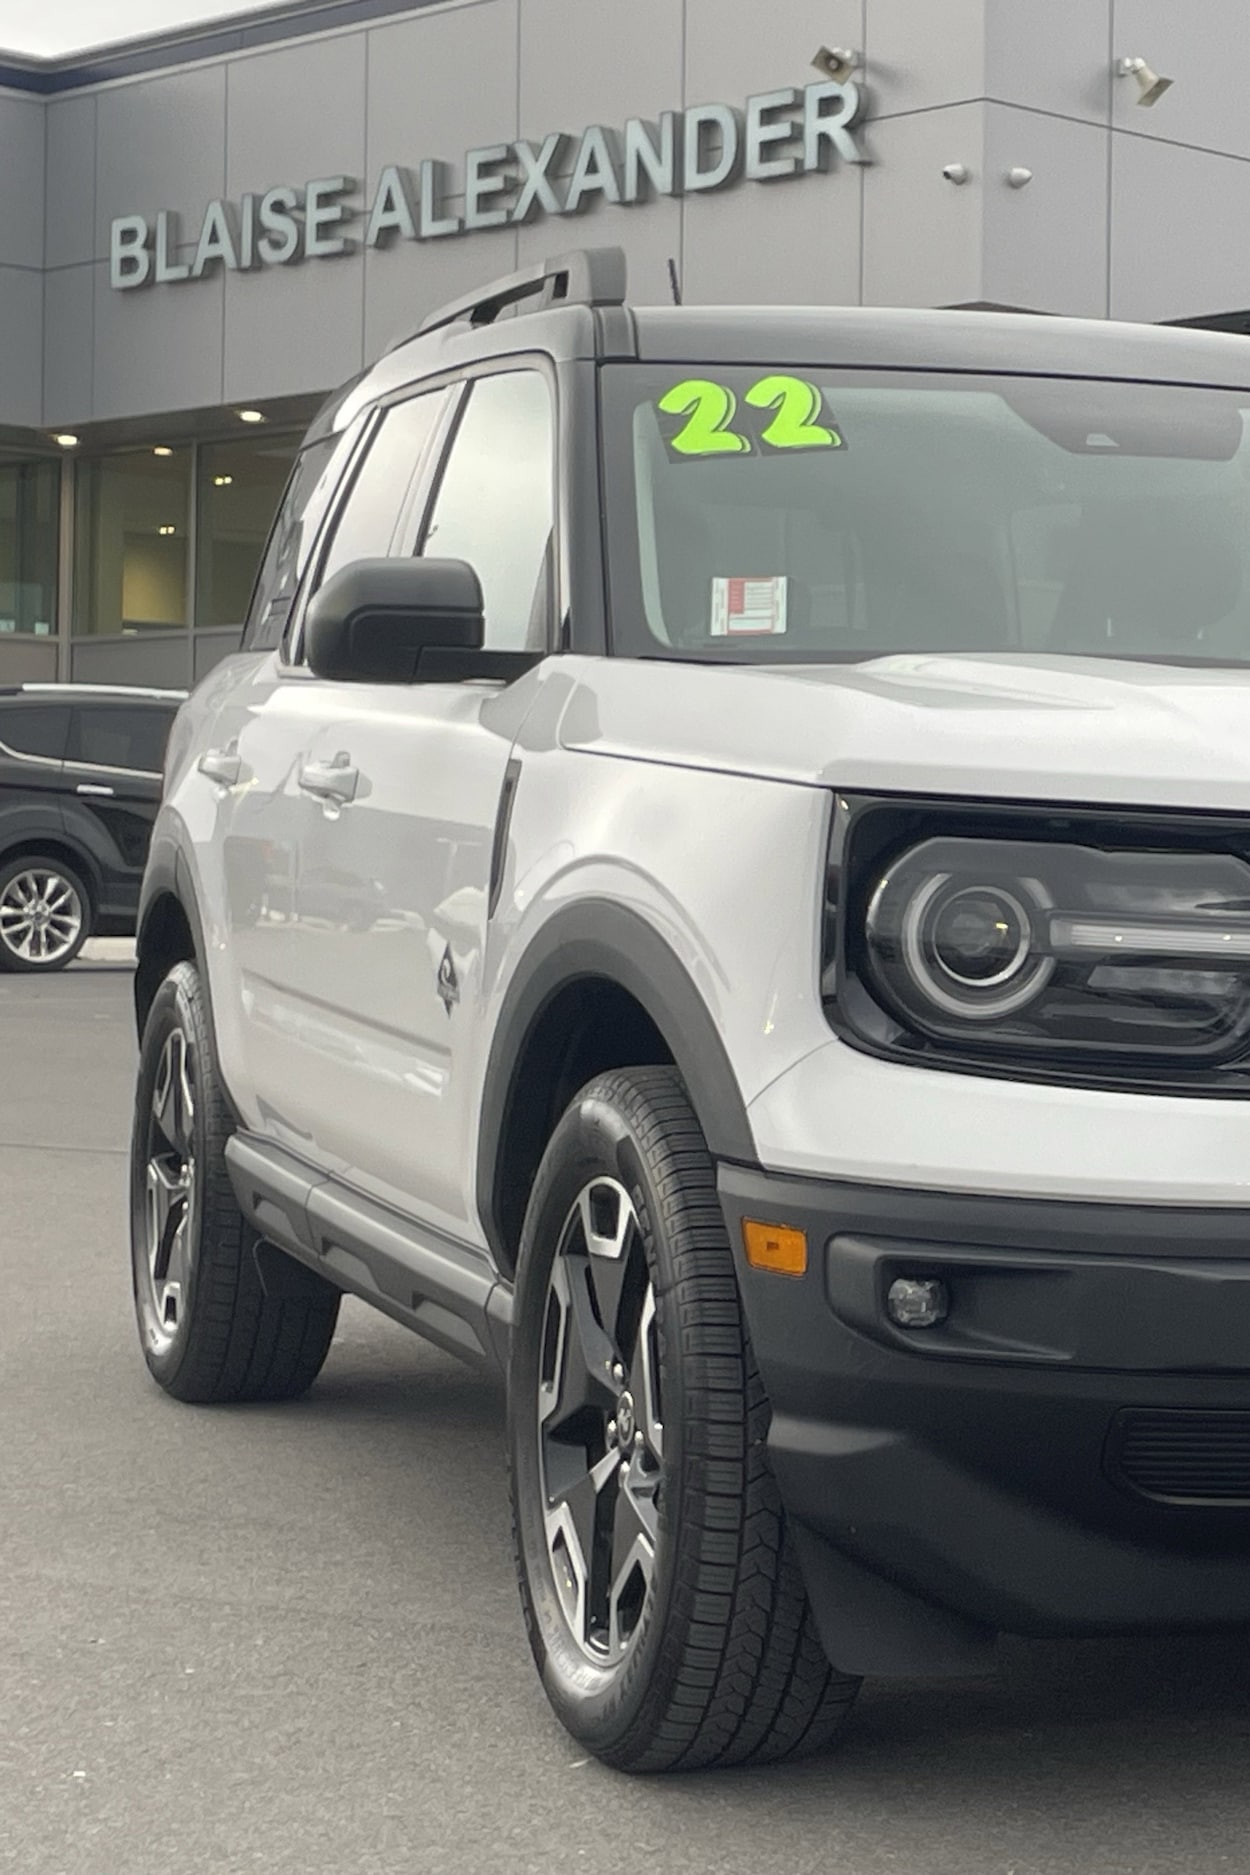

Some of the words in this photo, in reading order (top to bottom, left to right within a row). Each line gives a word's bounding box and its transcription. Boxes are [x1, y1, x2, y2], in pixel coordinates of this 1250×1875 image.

[111, 175, 347, 290] BLAISE
[366, 80, 865, 247] ALEXANDER
[658, 375, 841, 455] 22
